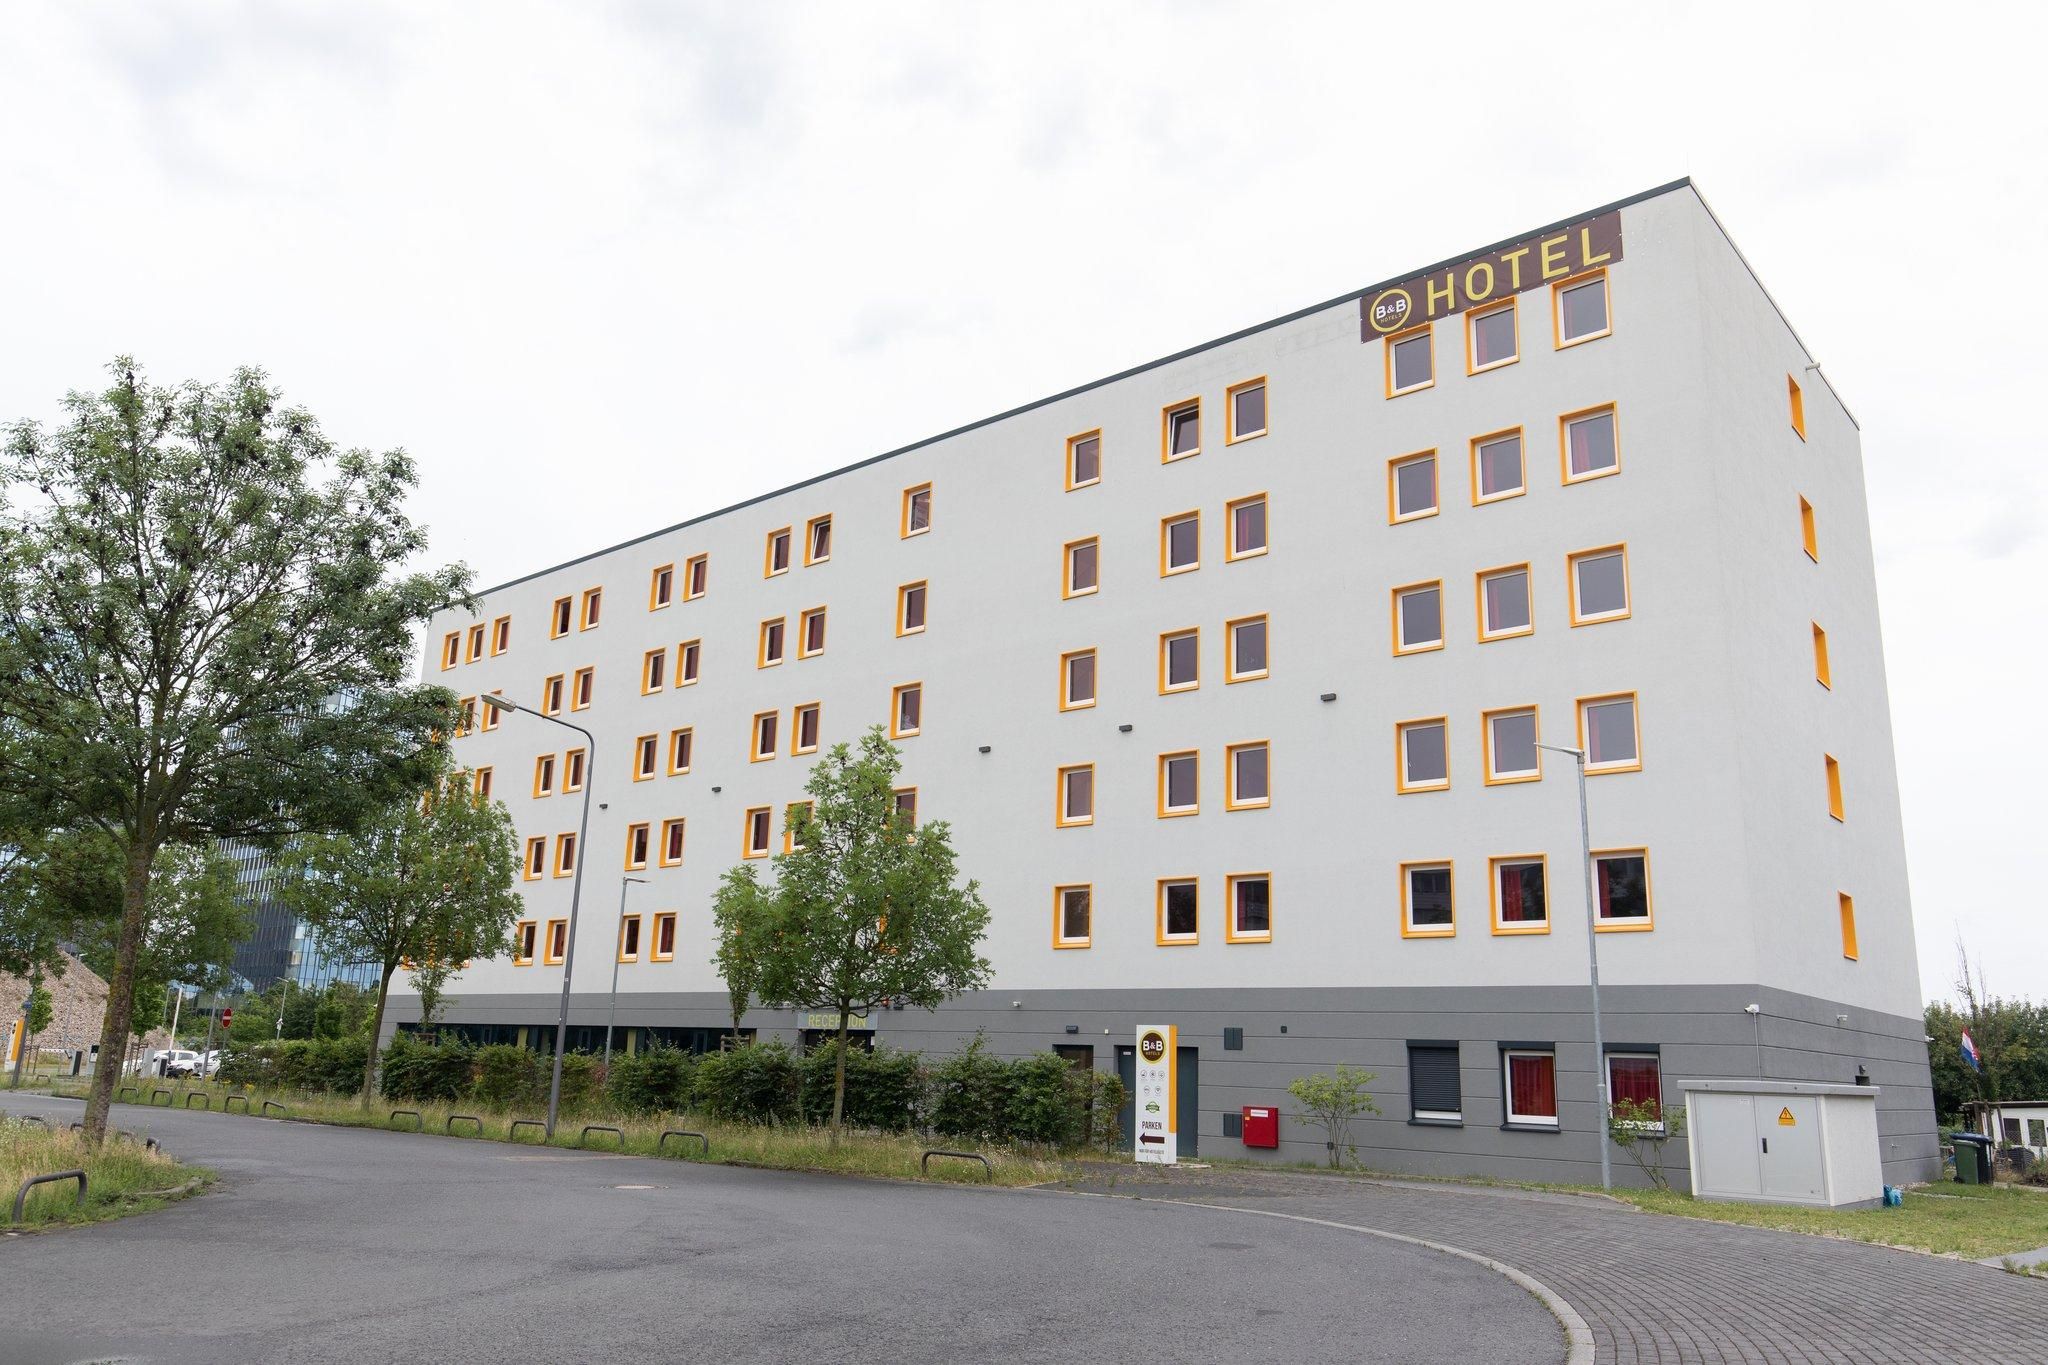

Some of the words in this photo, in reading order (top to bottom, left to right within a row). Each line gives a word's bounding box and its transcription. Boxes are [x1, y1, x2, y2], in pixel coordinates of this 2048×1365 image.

[1427, 228, 1611, 315] HOTEL
[1376, 299, 1406, 319] B&B
[1380, 313, 1402, 324] HOTELS
[808, 1014, 866, 1027] RECEPION
[1143, 1040, 1163, 1051] B&B
[1142, 1121, 1162, 1130] PARKEN
